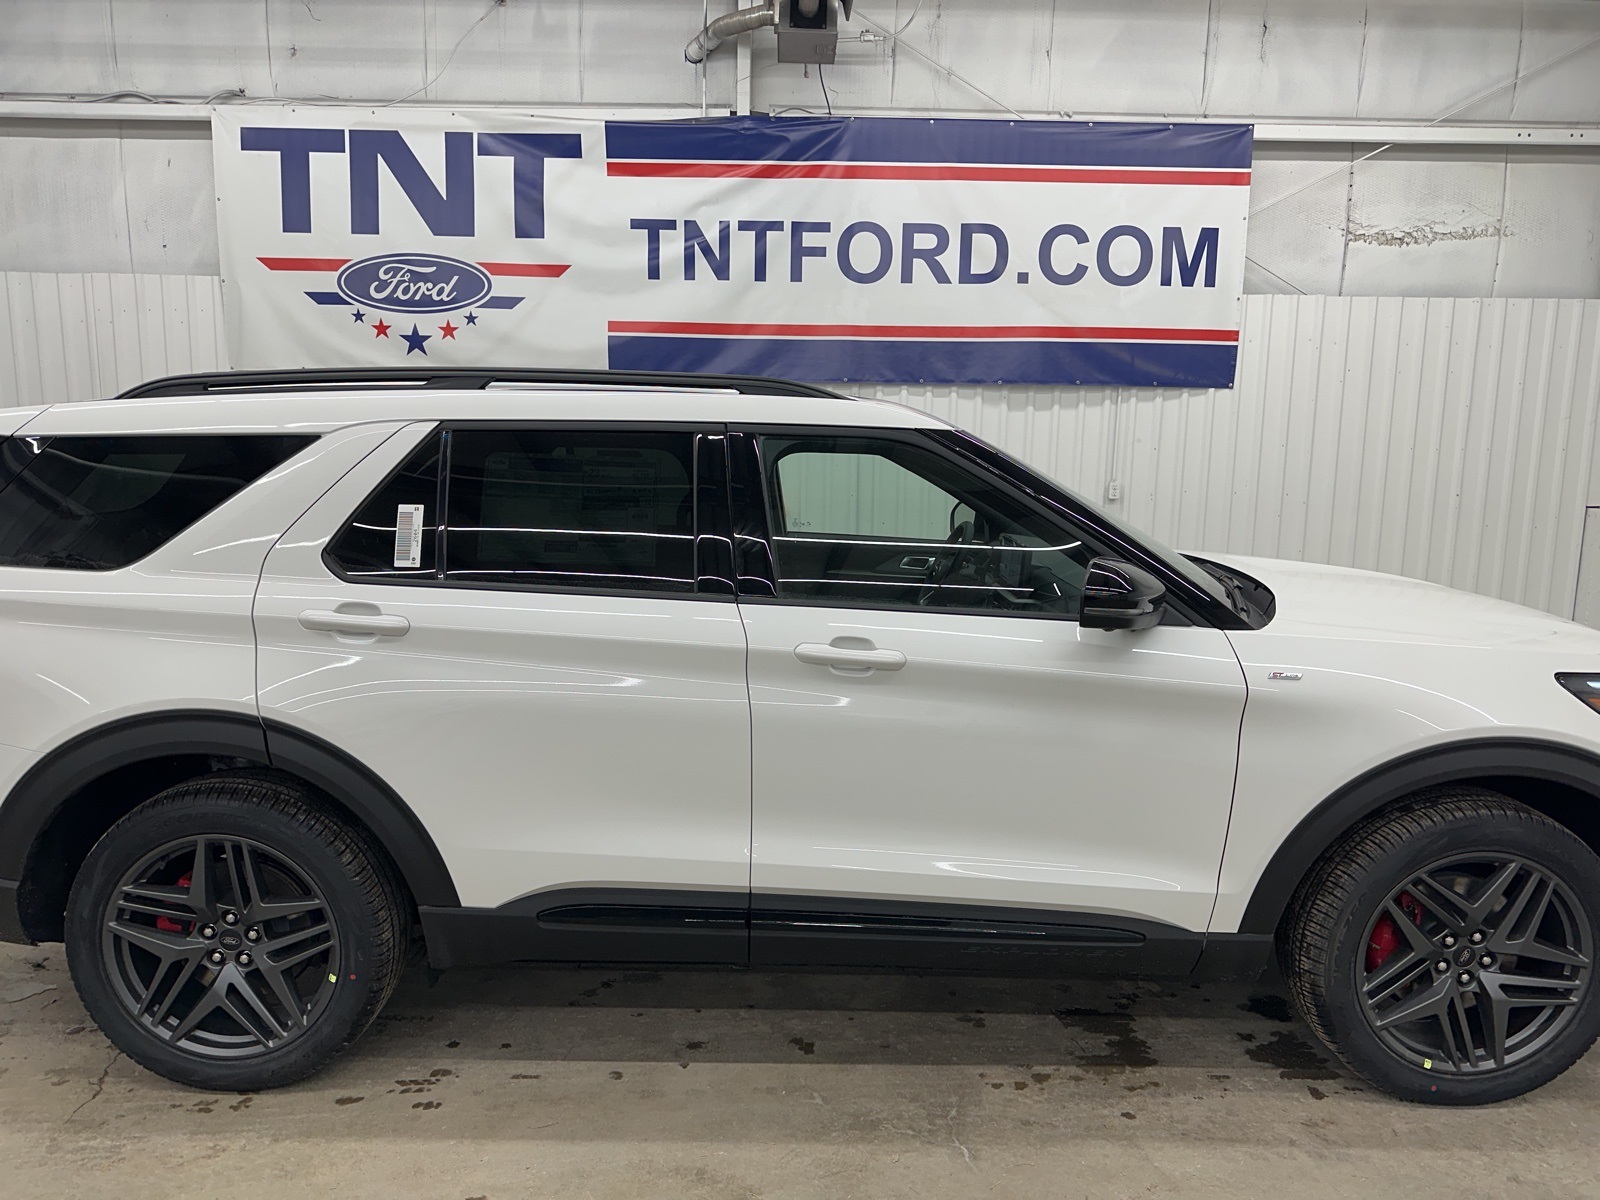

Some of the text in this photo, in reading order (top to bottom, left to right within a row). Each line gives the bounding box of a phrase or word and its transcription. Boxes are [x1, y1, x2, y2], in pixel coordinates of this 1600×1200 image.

[240, 127, 582, 239] TNT
[369, 263, 460, 301] Ford
[630, 218, 1220, 288] TNTFORD.COM
